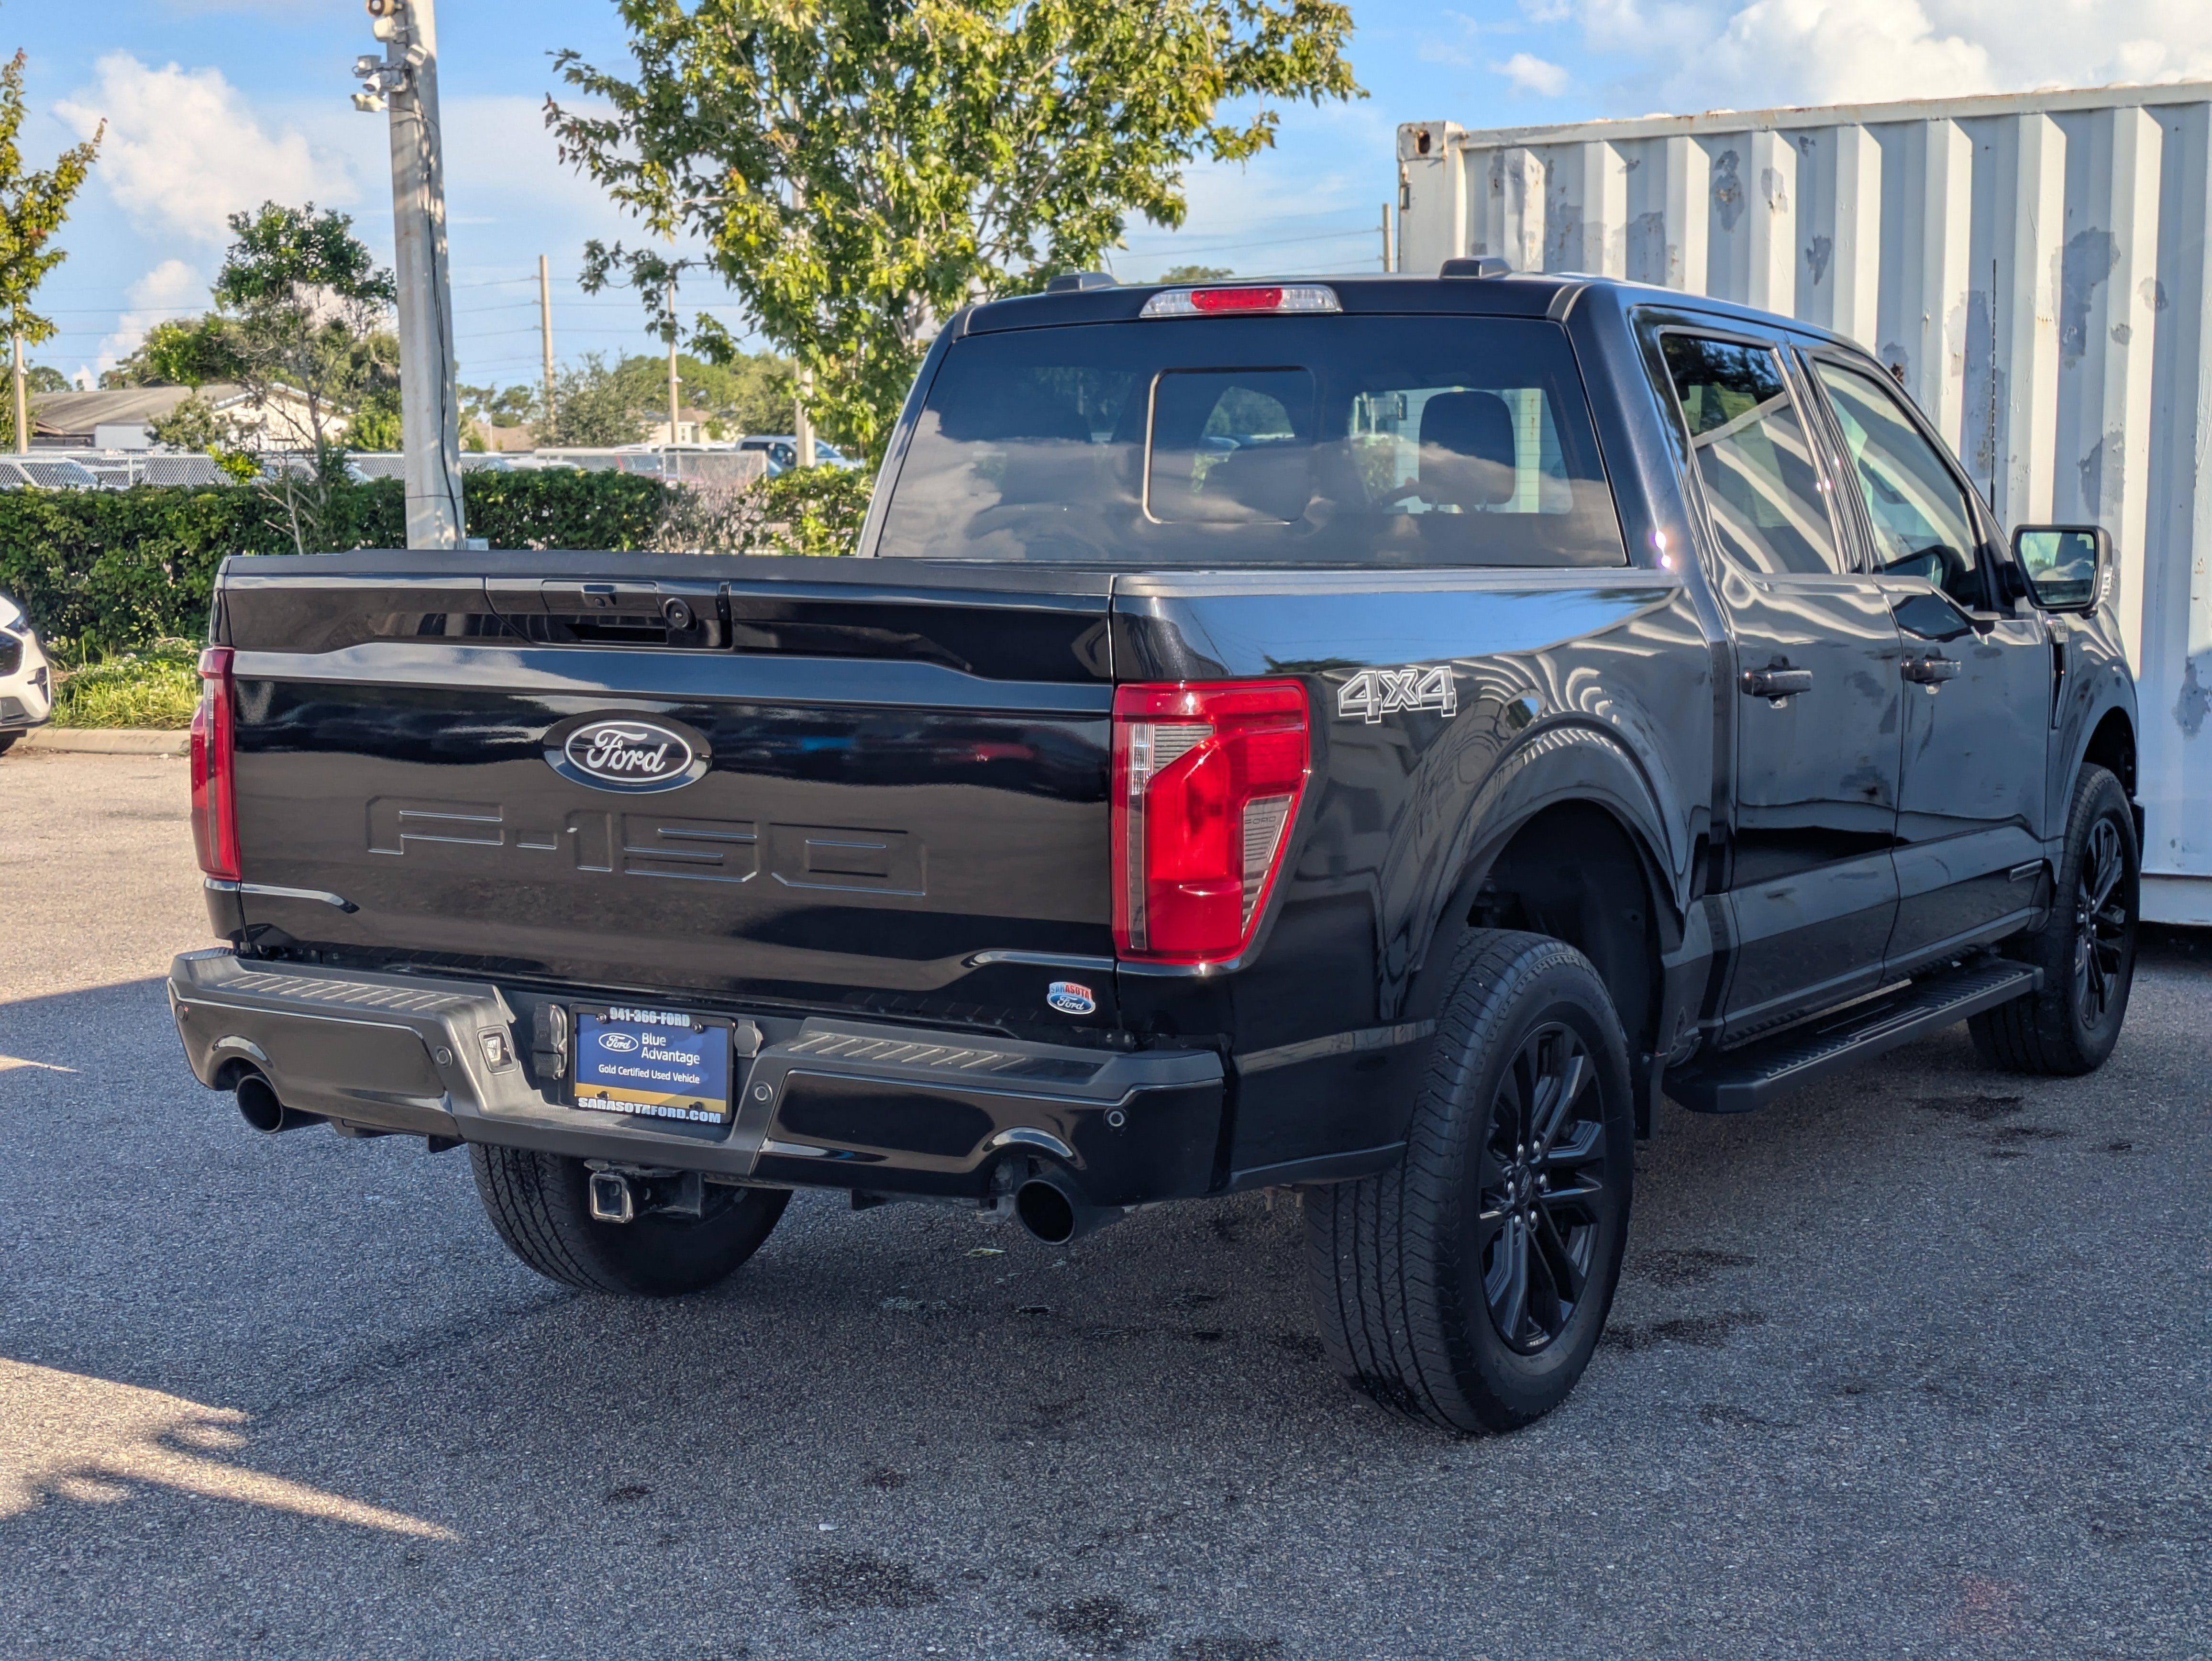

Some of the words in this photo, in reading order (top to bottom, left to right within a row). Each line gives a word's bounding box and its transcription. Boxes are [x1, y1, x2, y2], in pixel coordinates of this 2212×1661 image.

[586, 728, 667, 774] Ford
[1245, 816, 1276, 824] FORD
[365, 795, 927, 896] F-150
[1050, 984, 1090, 1000] SARASOTA
[1057, 995, 1084, 1010] Ford
[609, 1007, 690, 1027] 941-366-FORD
[606, 1035, 632, 1049] Ford
[641, 1032, 667, 1047] Blue
[641, 1046, 700, 1065] Advantage
[598, 1064, 616, 1074] Gold
[618, 1066, 649, 1078] Certified
[651, 1070, 671, 1081] Used
[673, 1073, 700, 1084] Vehicle
[578, 1097, 721, 1124] SARASOTAFORD.COM
